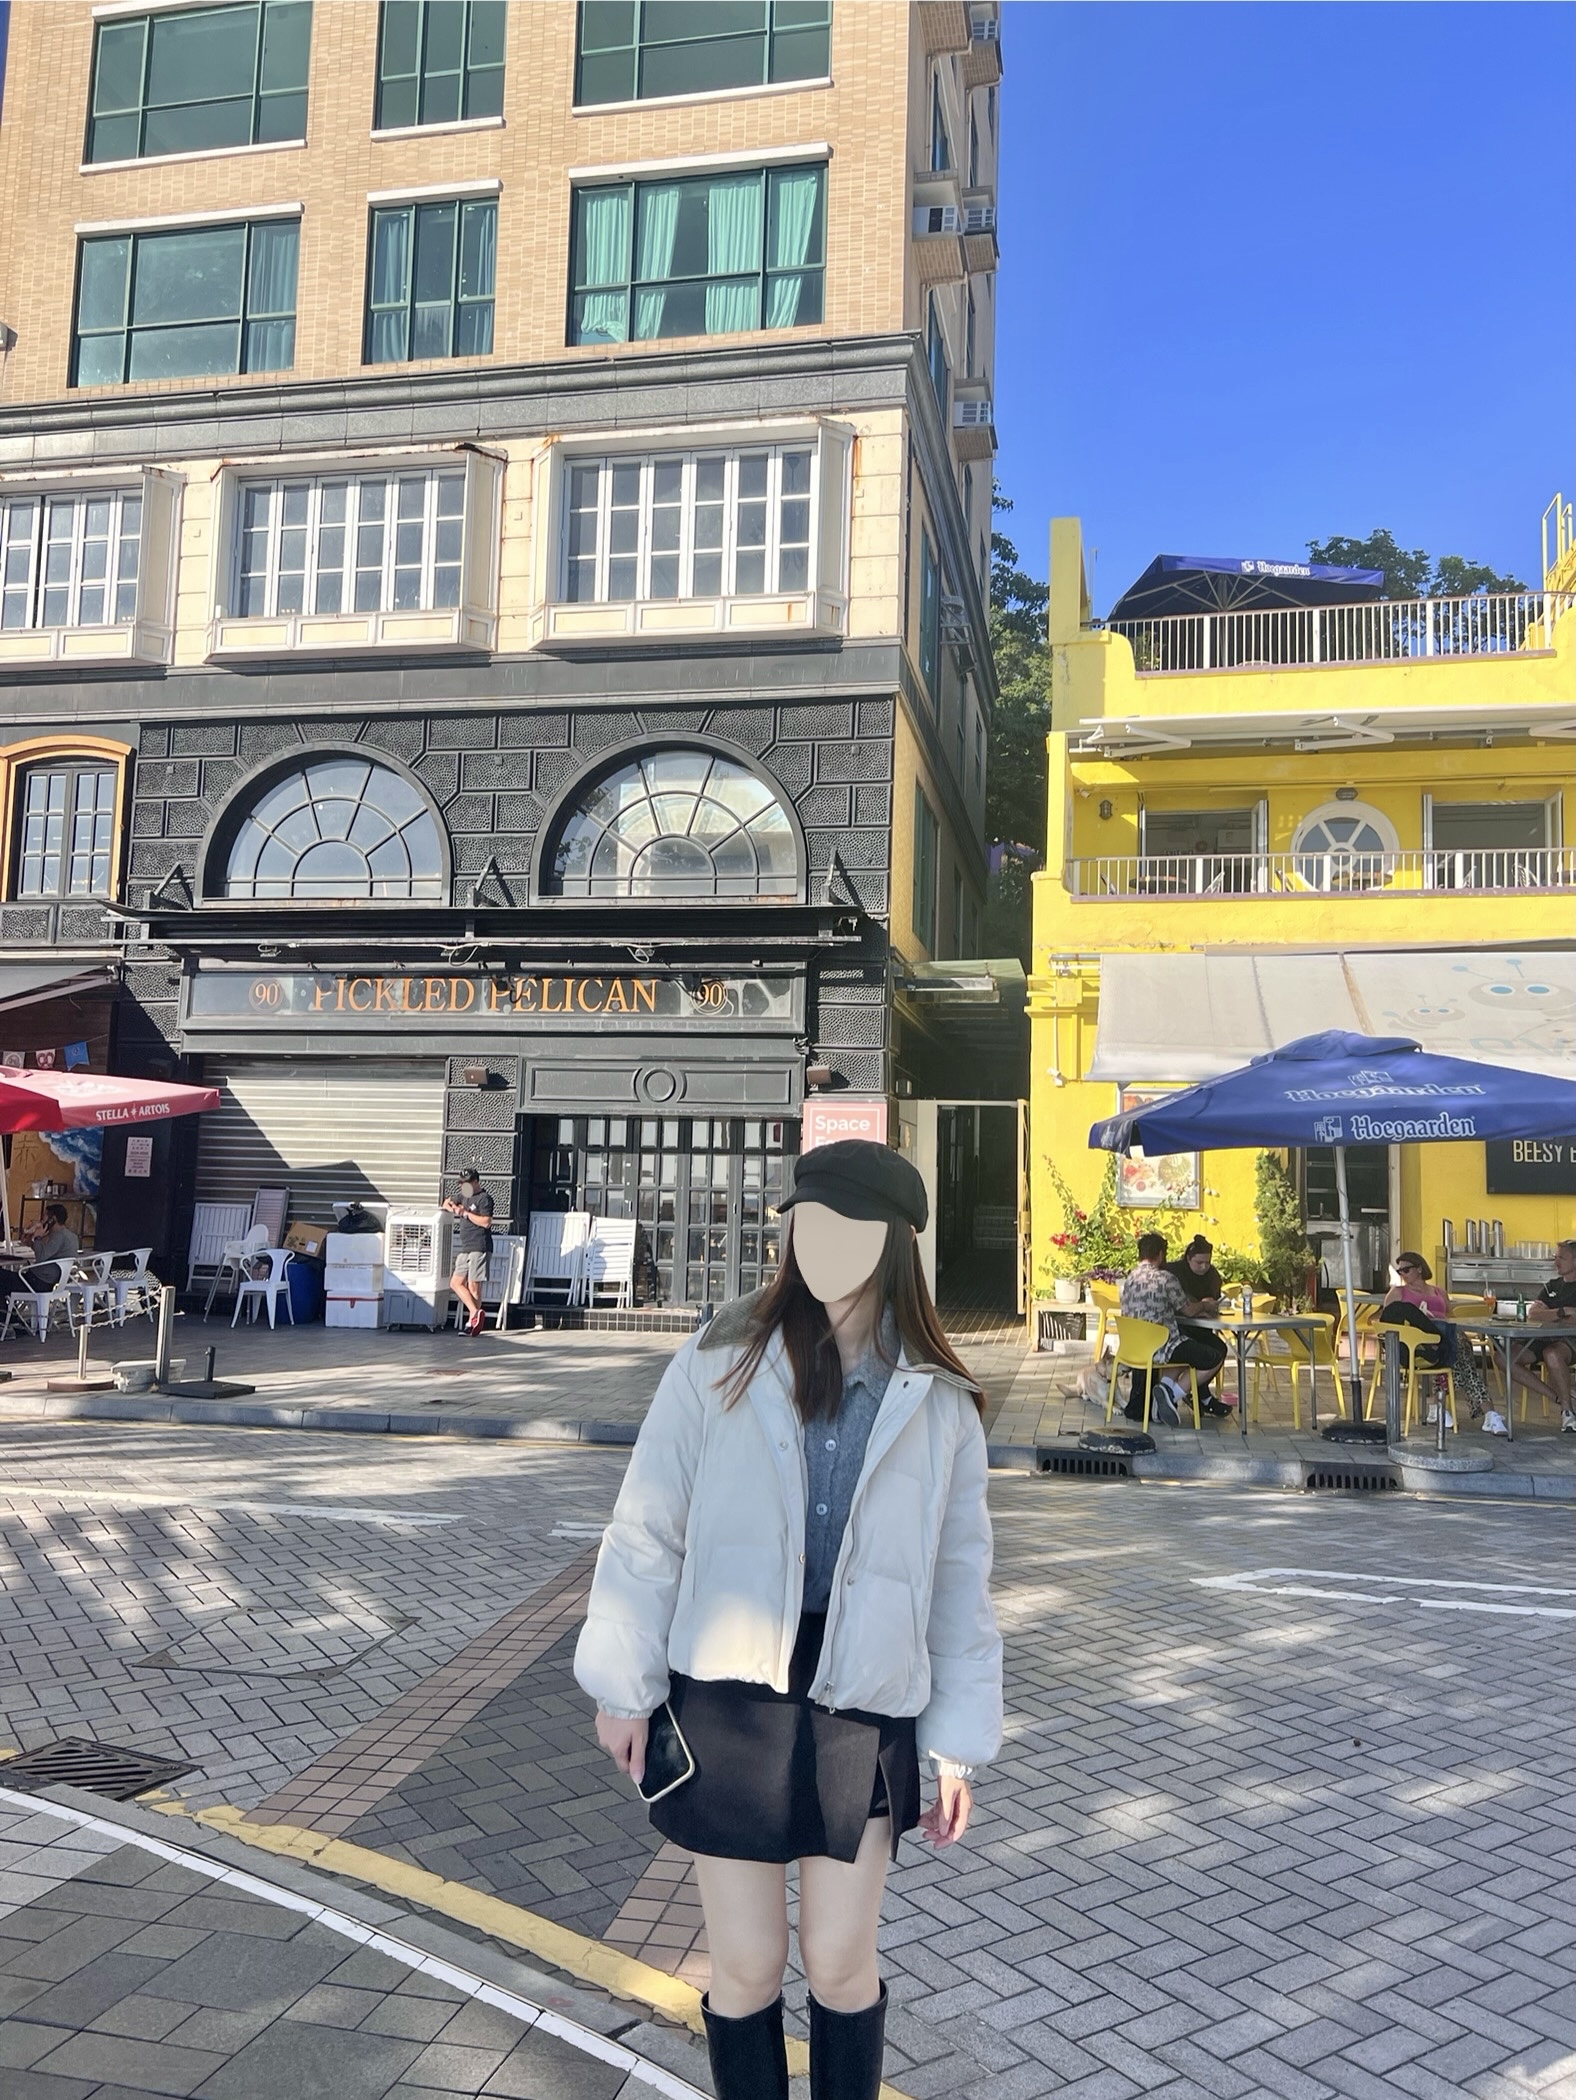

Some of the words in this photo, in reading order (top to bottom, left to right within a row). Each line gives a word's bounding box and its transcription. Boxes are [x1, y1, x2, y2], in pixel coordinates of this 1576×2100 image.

[1257, 561, 1311, 577] Hoegaarden
[255, 983, 279, 1006] 90
[312, 977, 475, 1011] PICKLED
[487, 977, 658, 1012] PELICAN
[697, 983, 722, 1007] 90
[1284, 1083, 1486, 1102] Hoegaarden
[96, 1107, 129, 1121] STELLA
[138, 1103, 170, 1117] ARTOIS
[815, 1115, 871, 1134] Space
[1351, 1111, 1476, 1141] Hoegaarden
[1513, 1139, 1563, 1163] BEESY
